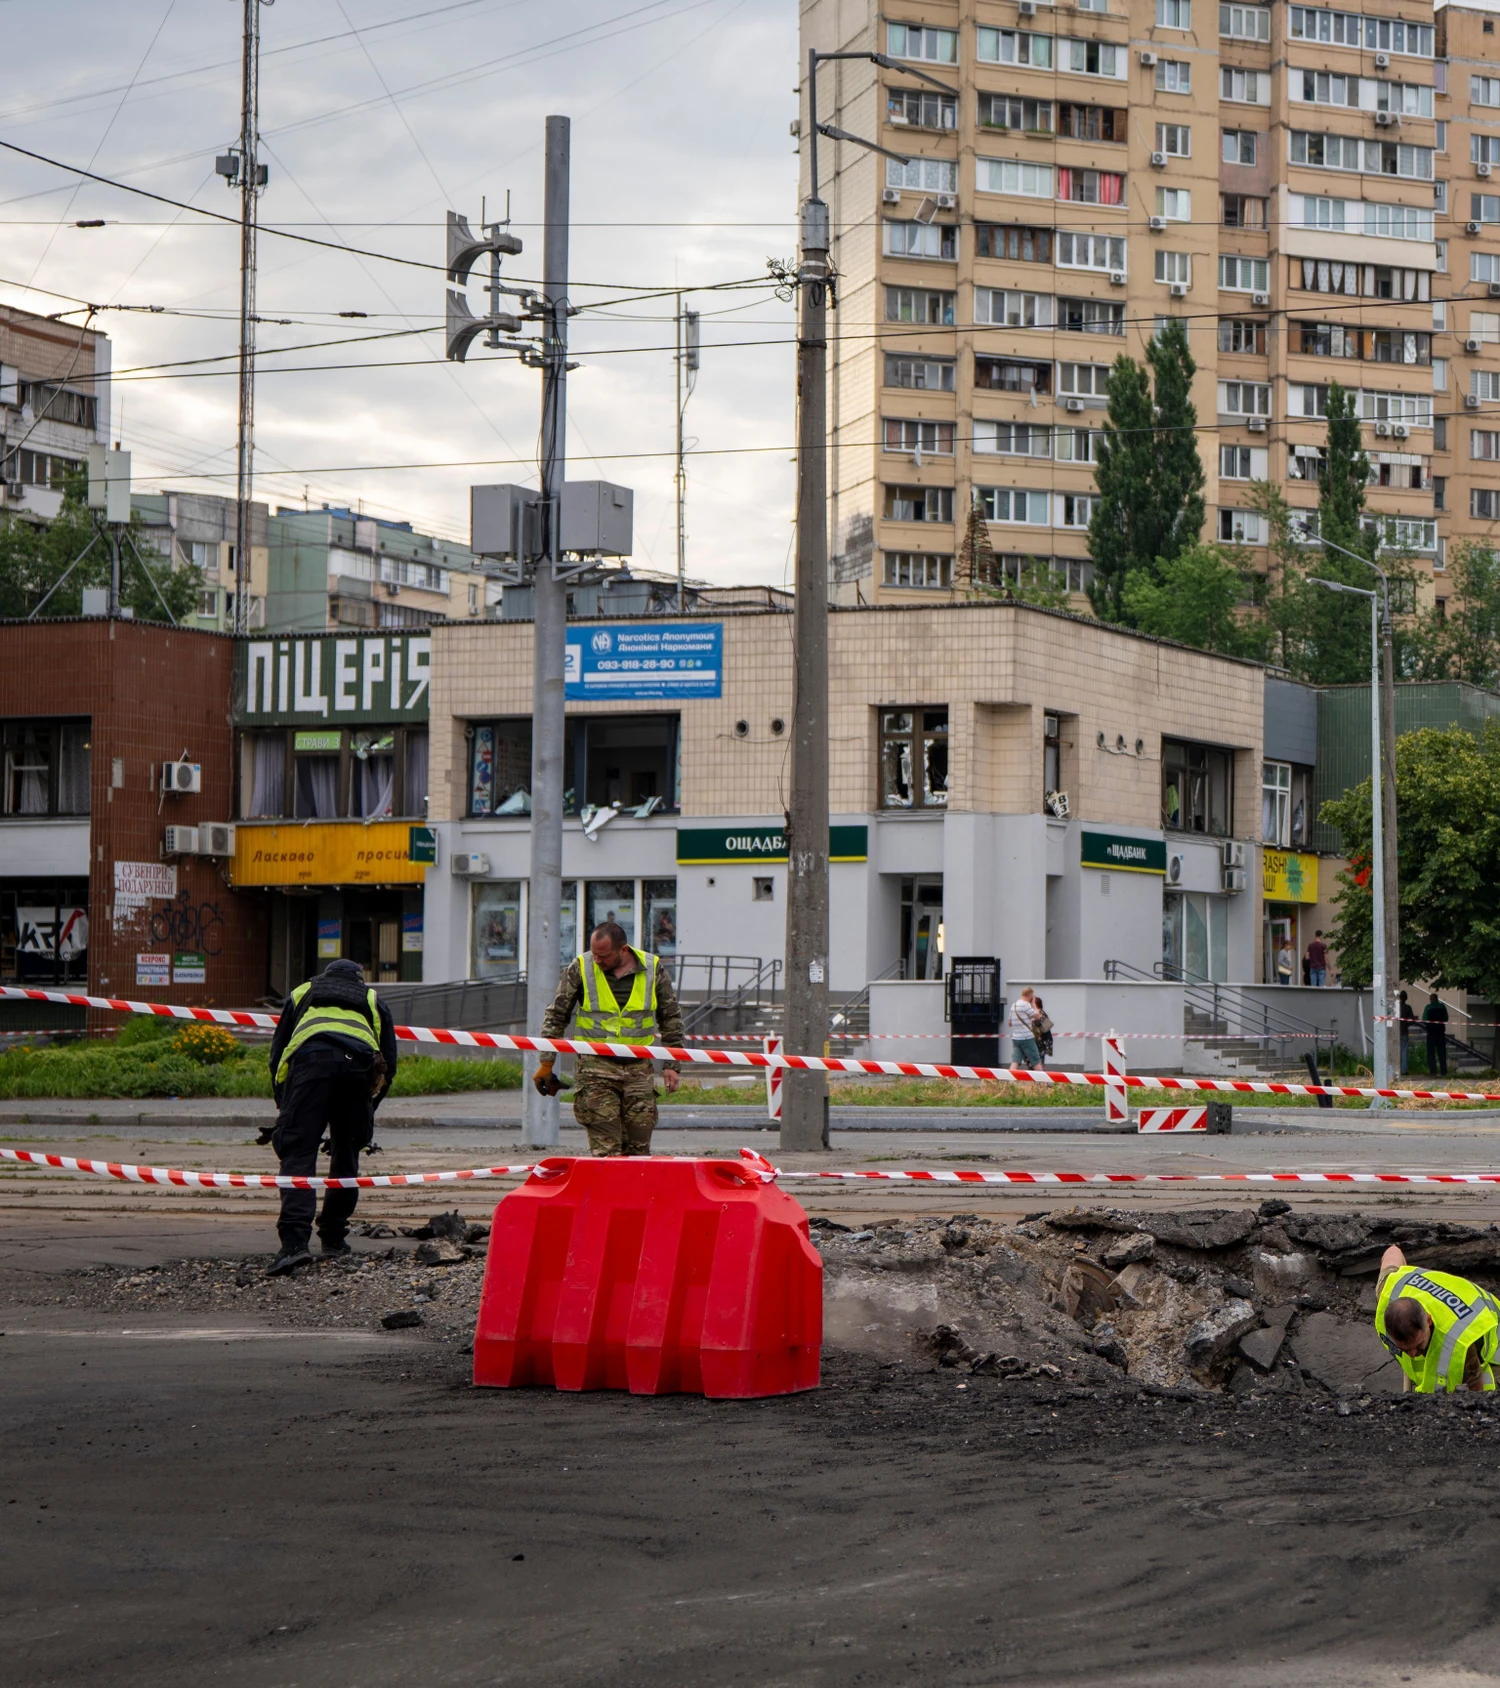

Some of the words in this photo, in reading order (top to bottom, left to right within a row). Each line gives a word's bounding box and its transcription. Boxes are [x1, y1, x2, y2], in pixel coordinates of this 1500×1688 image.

[617, 633, 660, 643] Narcotics
[662, 632, 715, 642] Anonymous
[617, 643, 659, 652] Анонімні
[661, 642, 712, 652] Наркомани
[597, 659, 675, 670] 093-918-28-90
[295, 734, 330, 749] СТРАВИ
[252, 850, 315, 863] Ласкаво
[118, 879, 174, 895] ПОДАРУНКИ
